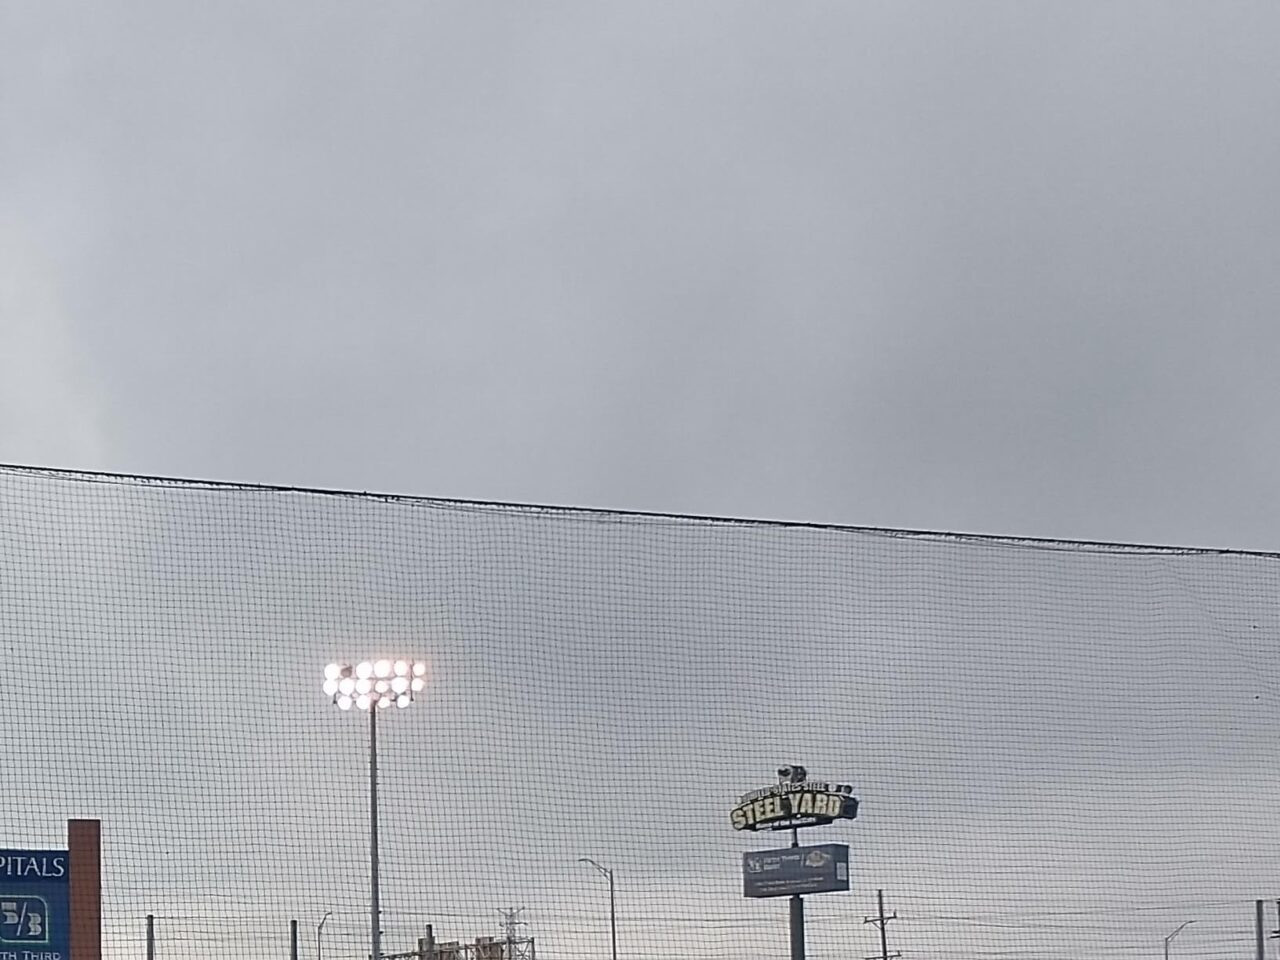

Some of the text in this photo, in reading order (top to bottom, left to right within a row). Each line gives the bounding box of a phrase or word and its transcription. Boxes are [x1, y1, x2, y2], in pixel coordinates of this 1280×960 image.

[731, 793, 841, 830] STEEL YARD
[22, 951, 61, 960] THIRD
